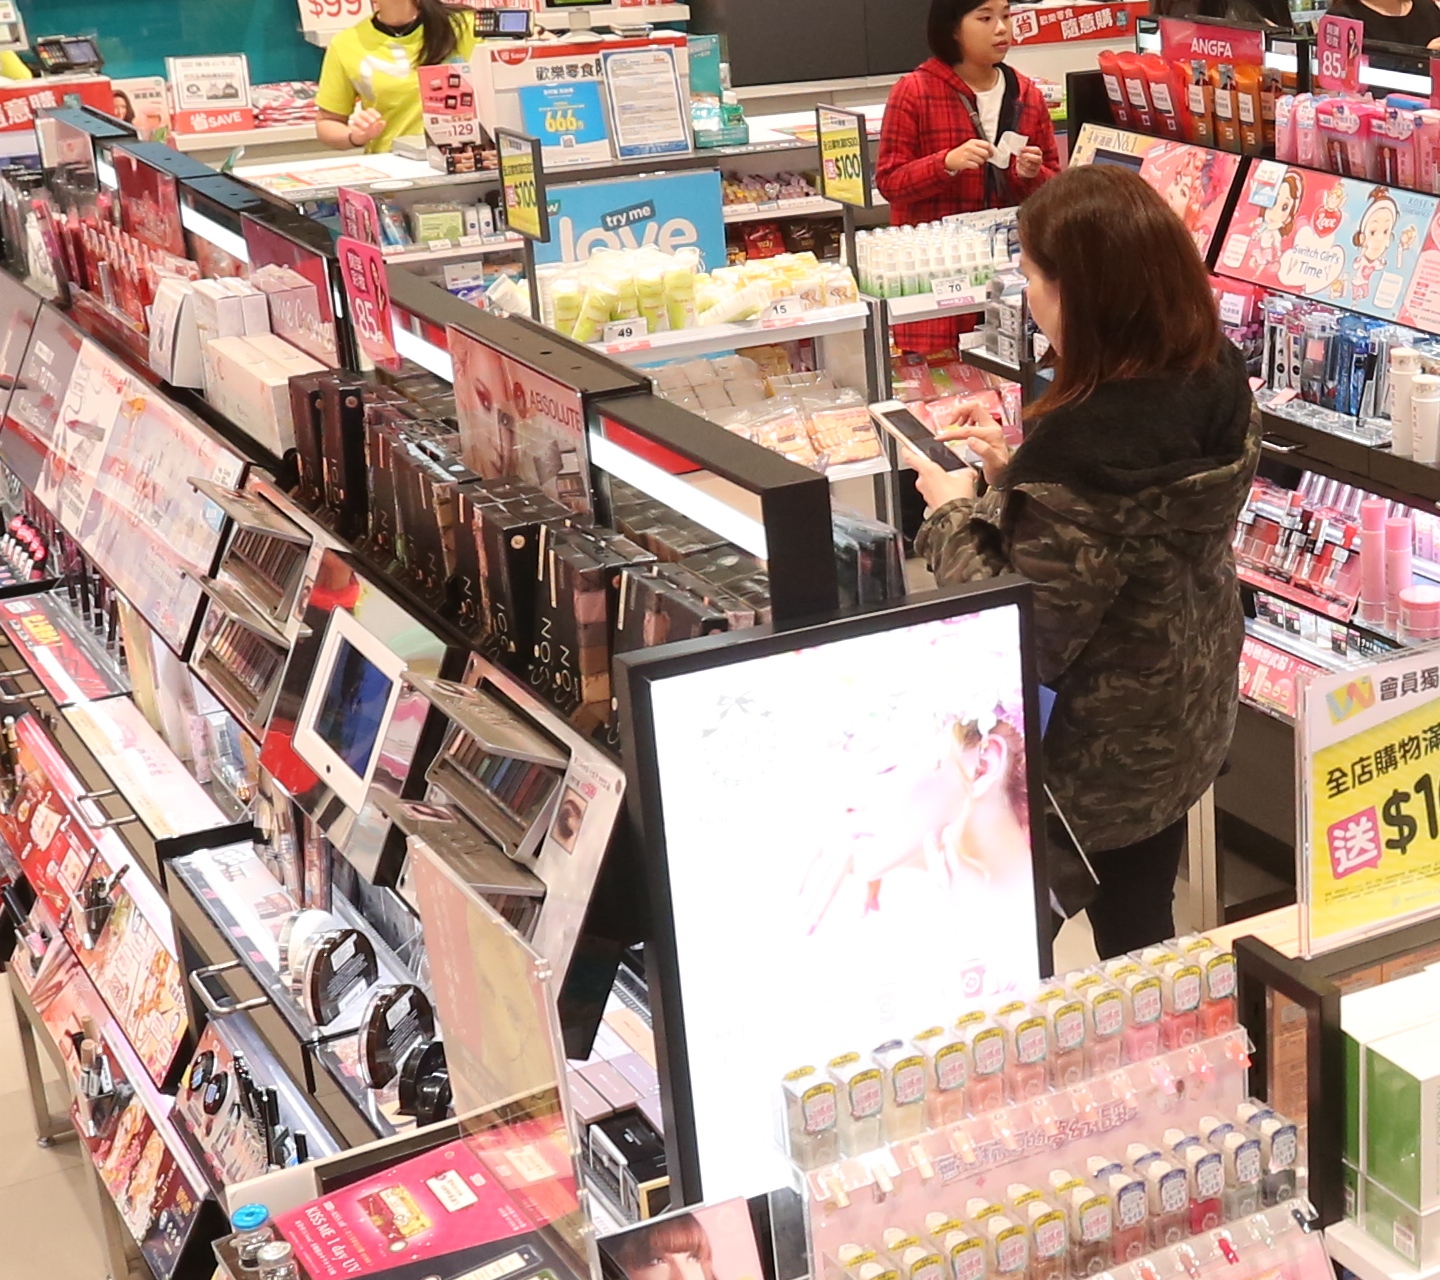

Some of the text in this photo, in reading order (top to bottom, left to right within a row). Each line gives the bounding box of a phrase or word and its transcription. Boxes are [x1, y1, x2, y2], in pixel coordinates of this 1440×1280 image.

[1191, 37, 1233, 58] ANGFA
[206, 109, 242, 128] SAVE
[605, 205, 652, 229] try me
[559, 218, 699, 264] love
[1291, 242, 1317, 262] Switch
[1299, 261, 1323, 280] Time
[947, 282, 963, 296] 70
[772, 304, 787, 315] 15
[618, 327, 633, 338] 49
[528, 390, 582, 435] ABSOLUTE
[1334, 818, 1379, 875] 送
